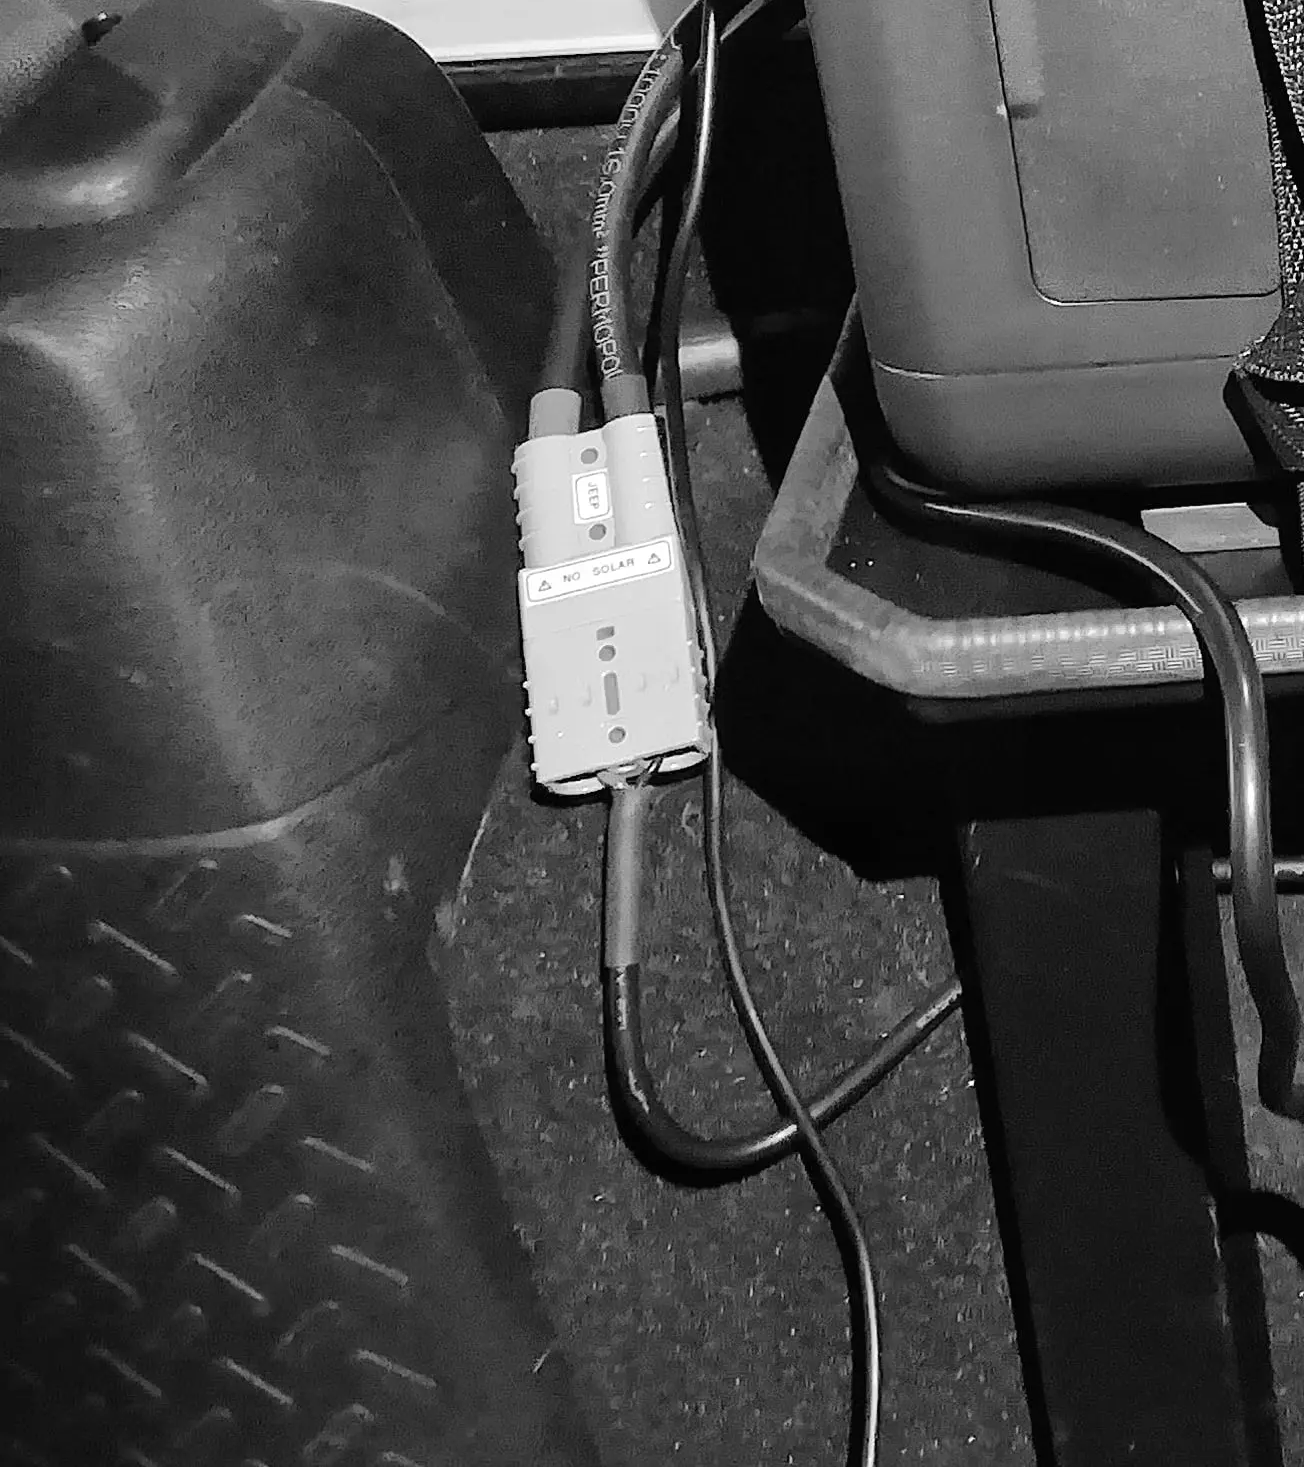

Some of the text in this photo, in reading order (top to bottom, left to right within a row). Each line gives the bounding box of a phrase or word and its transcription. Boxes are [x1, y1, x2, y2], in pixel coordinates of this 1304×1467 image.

[587, 481, 600, 510] JEEP
[563, 557, 635, 583] NO SOLAR
